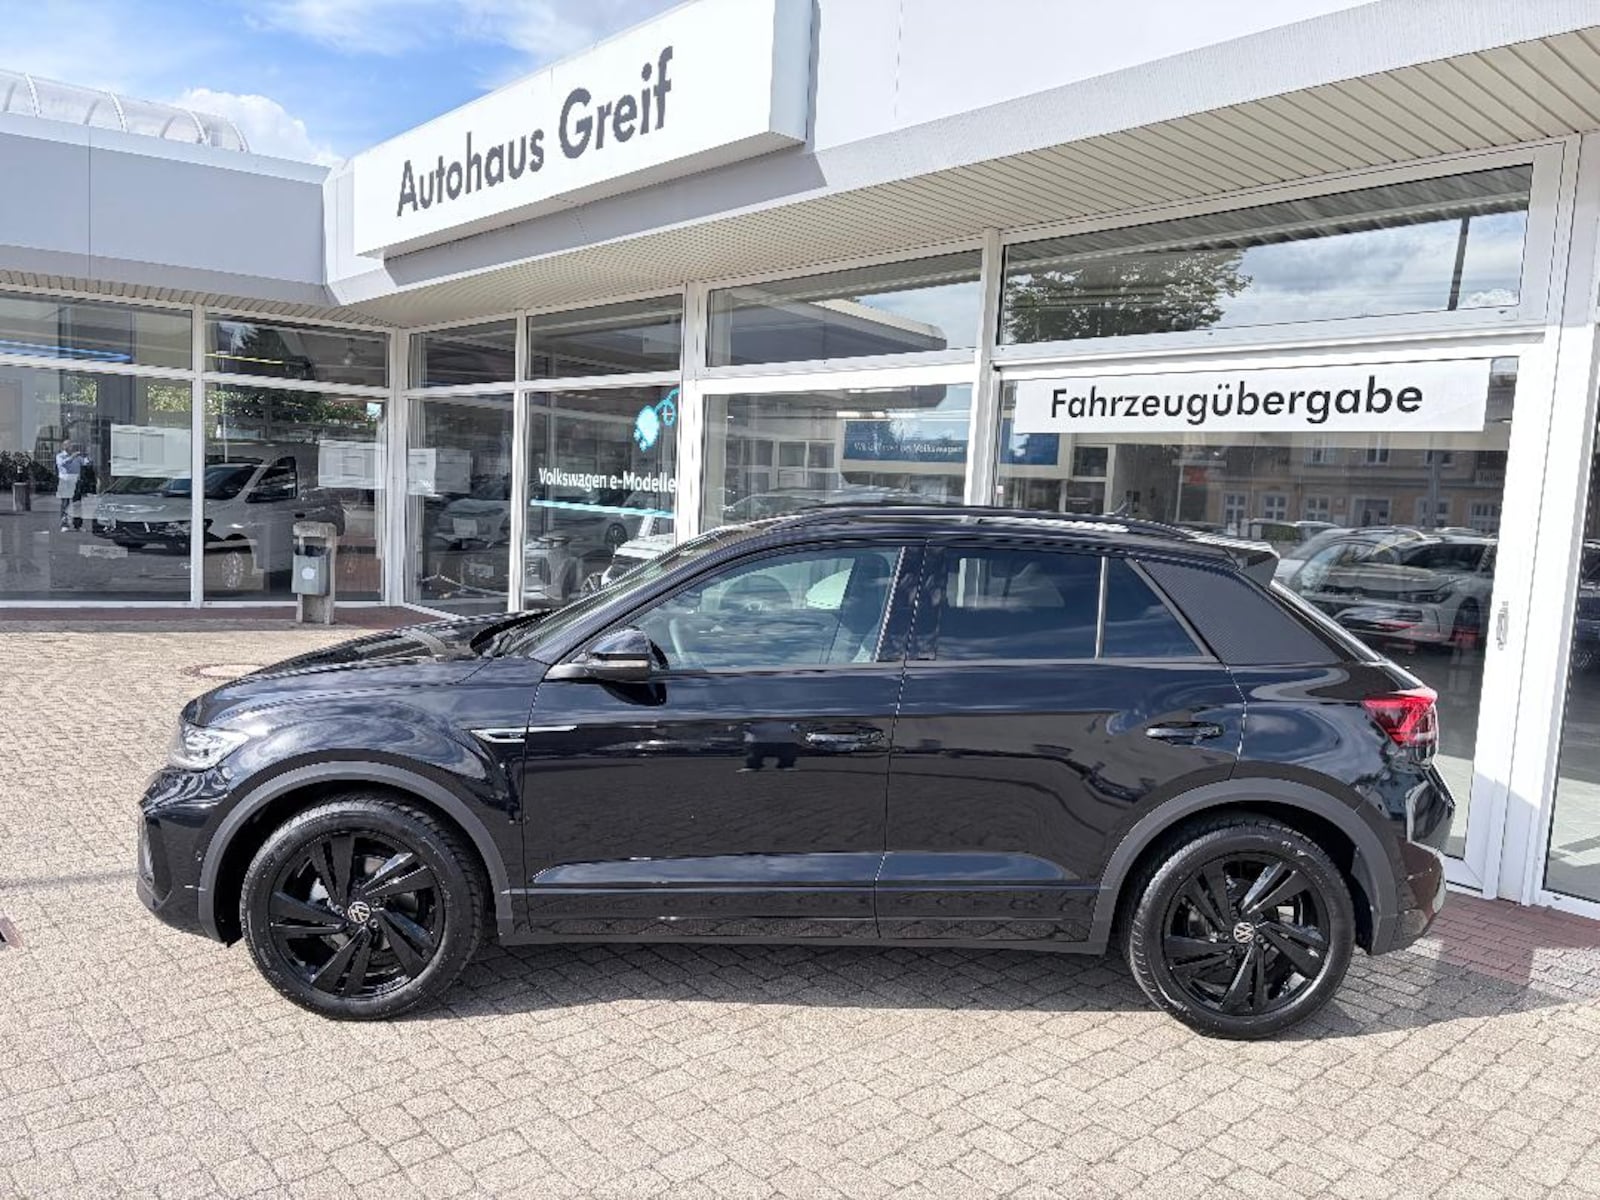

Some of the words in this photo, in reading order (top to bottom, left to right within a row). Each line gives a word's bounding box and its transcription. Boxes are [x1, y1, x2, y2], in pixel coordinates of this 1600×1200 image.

[396, 128, 545, 217] Autohaus
[558, 46, 674, 159] Greif
[1051, 375, 1423, 425] Fahrzeugübergabe
[538, 467, 607, 492] Volkswagen
[610, 471, 676, 494] e-Modelle
